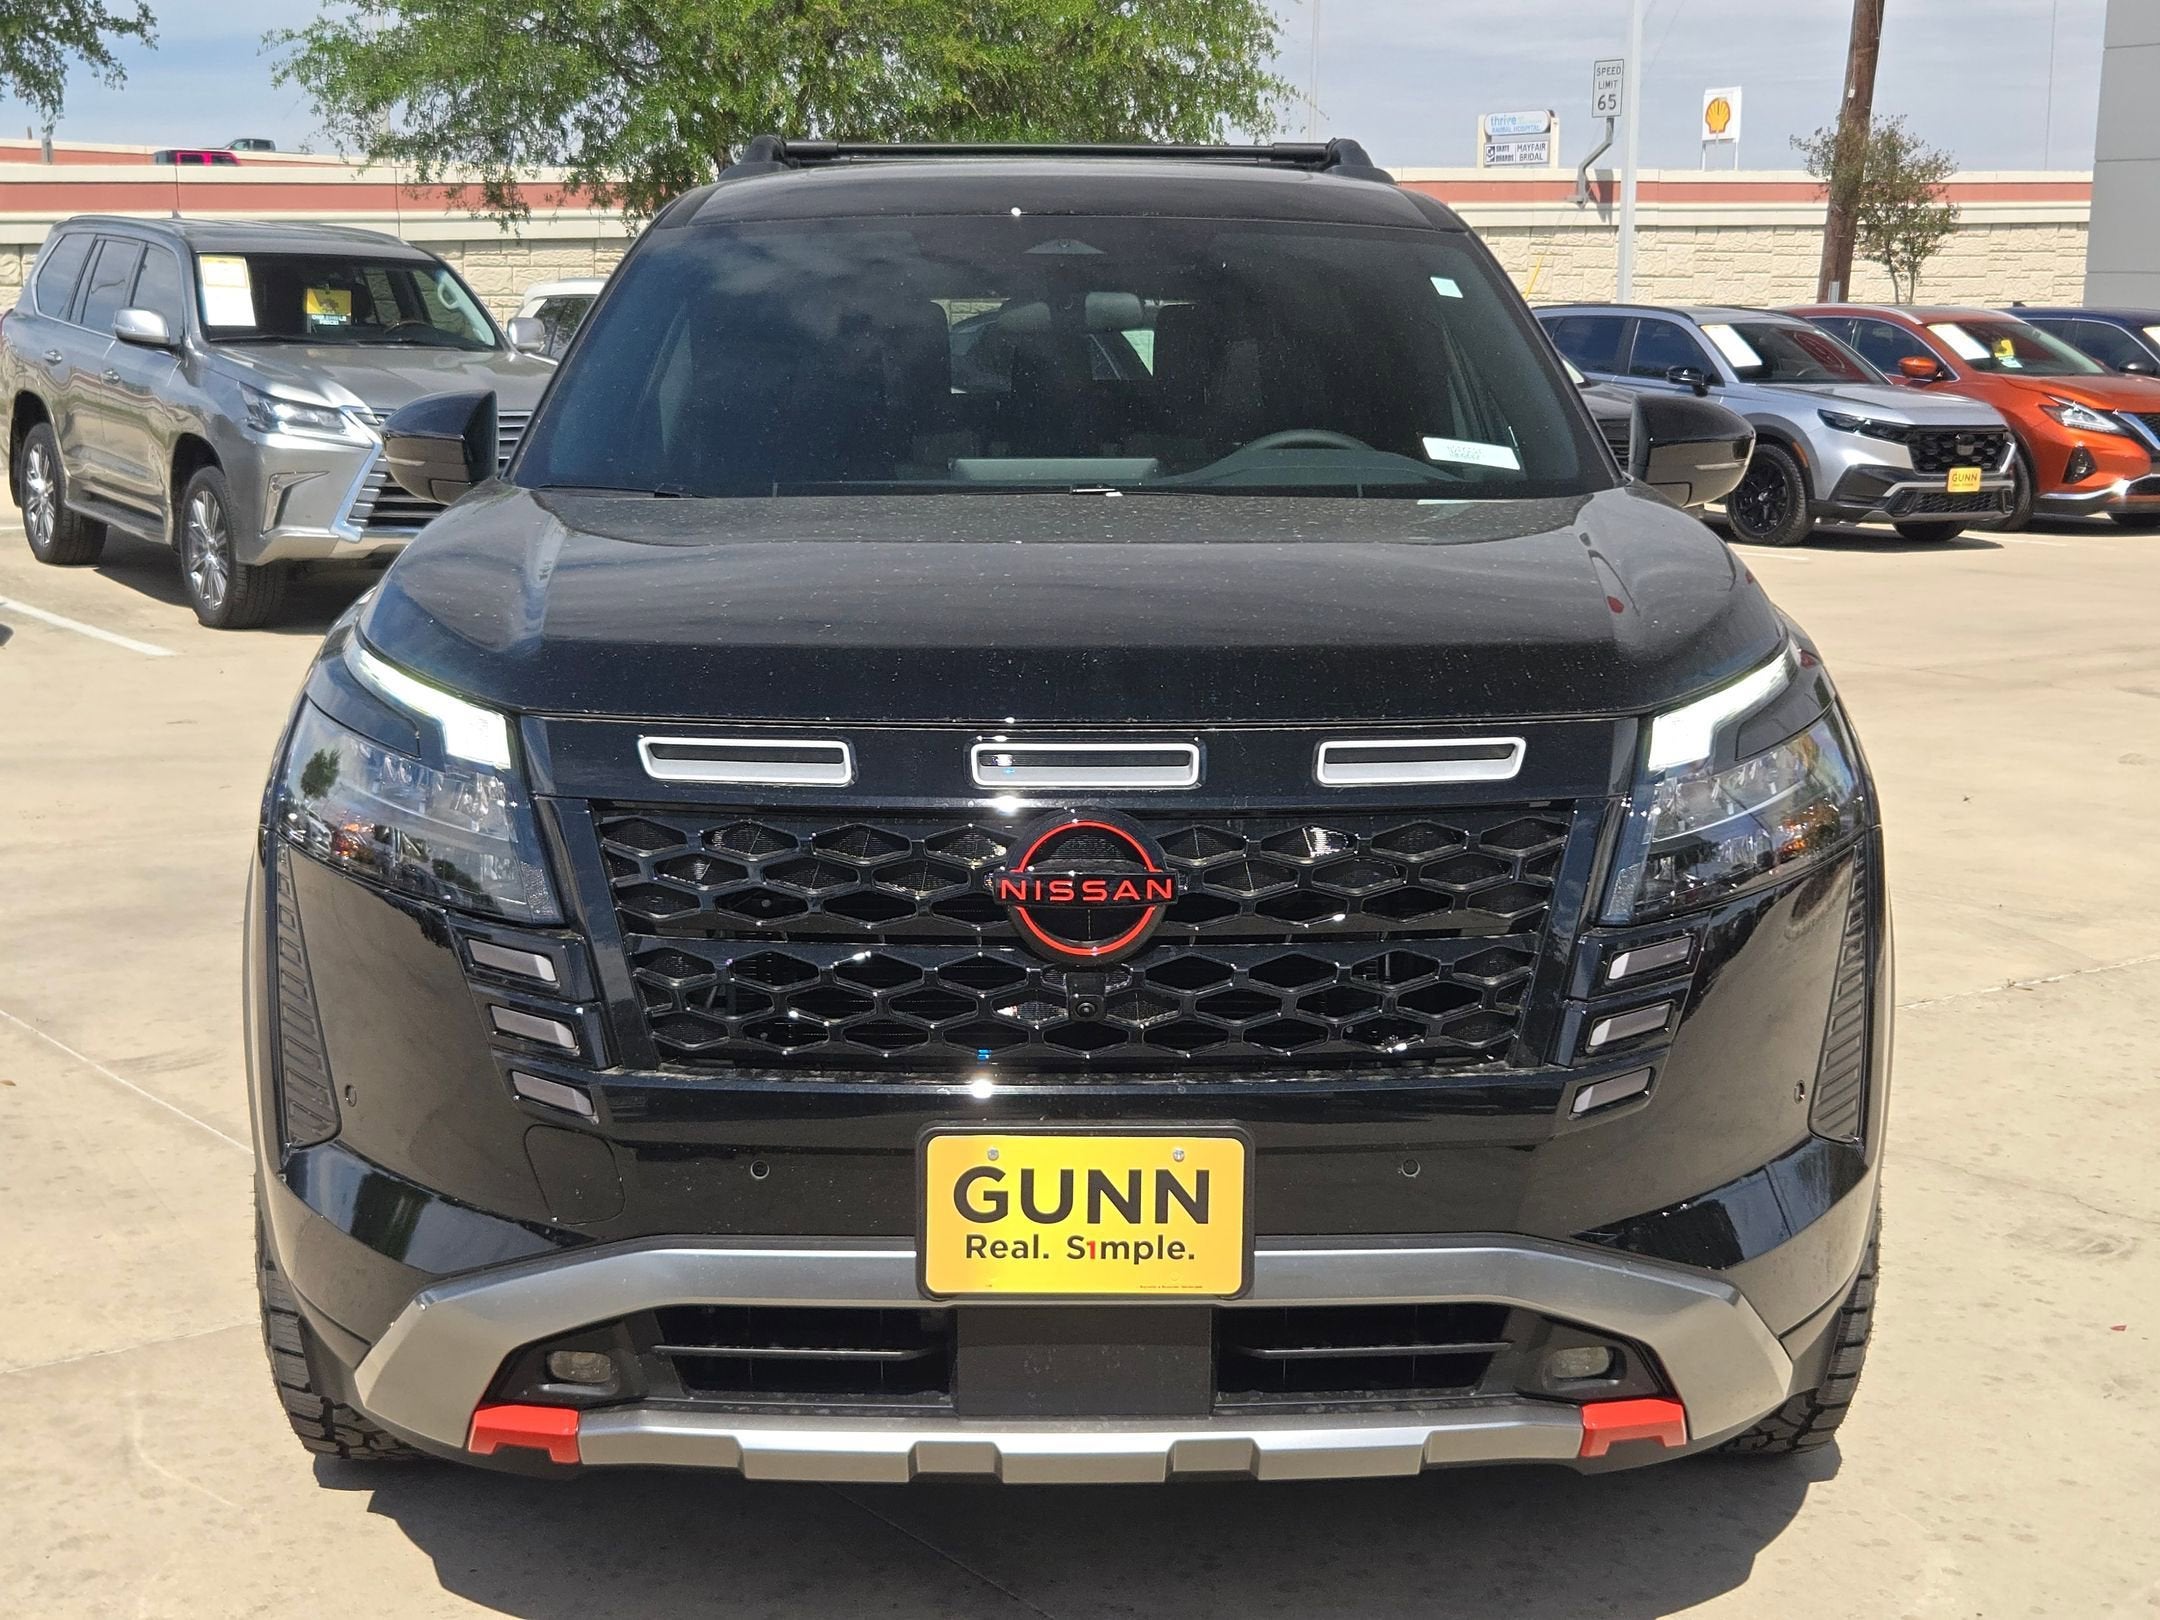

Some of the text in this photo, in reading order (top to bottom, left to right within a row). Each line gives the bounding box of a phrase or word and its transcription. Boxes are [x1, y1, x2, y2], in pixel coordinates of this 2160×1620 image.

[1596, 66, 1622, 77] SPEED
[1598, 80, 1617, 90] LIMIT
[1597, 94, 1617, 111] 65
[1490, 115, 1516, 127] thrive
[1517, 143, 1546, 153] MAYFAIR
[1519, 153, 1544, 162] BRIDAL
[1952, 473, 1978, 482] GUNN
[1001, 879, 1173, 902] NISSAN
[953, 1166, 1210, 1224] GUNN
[966, 1234, 1050, 1260] Real.
